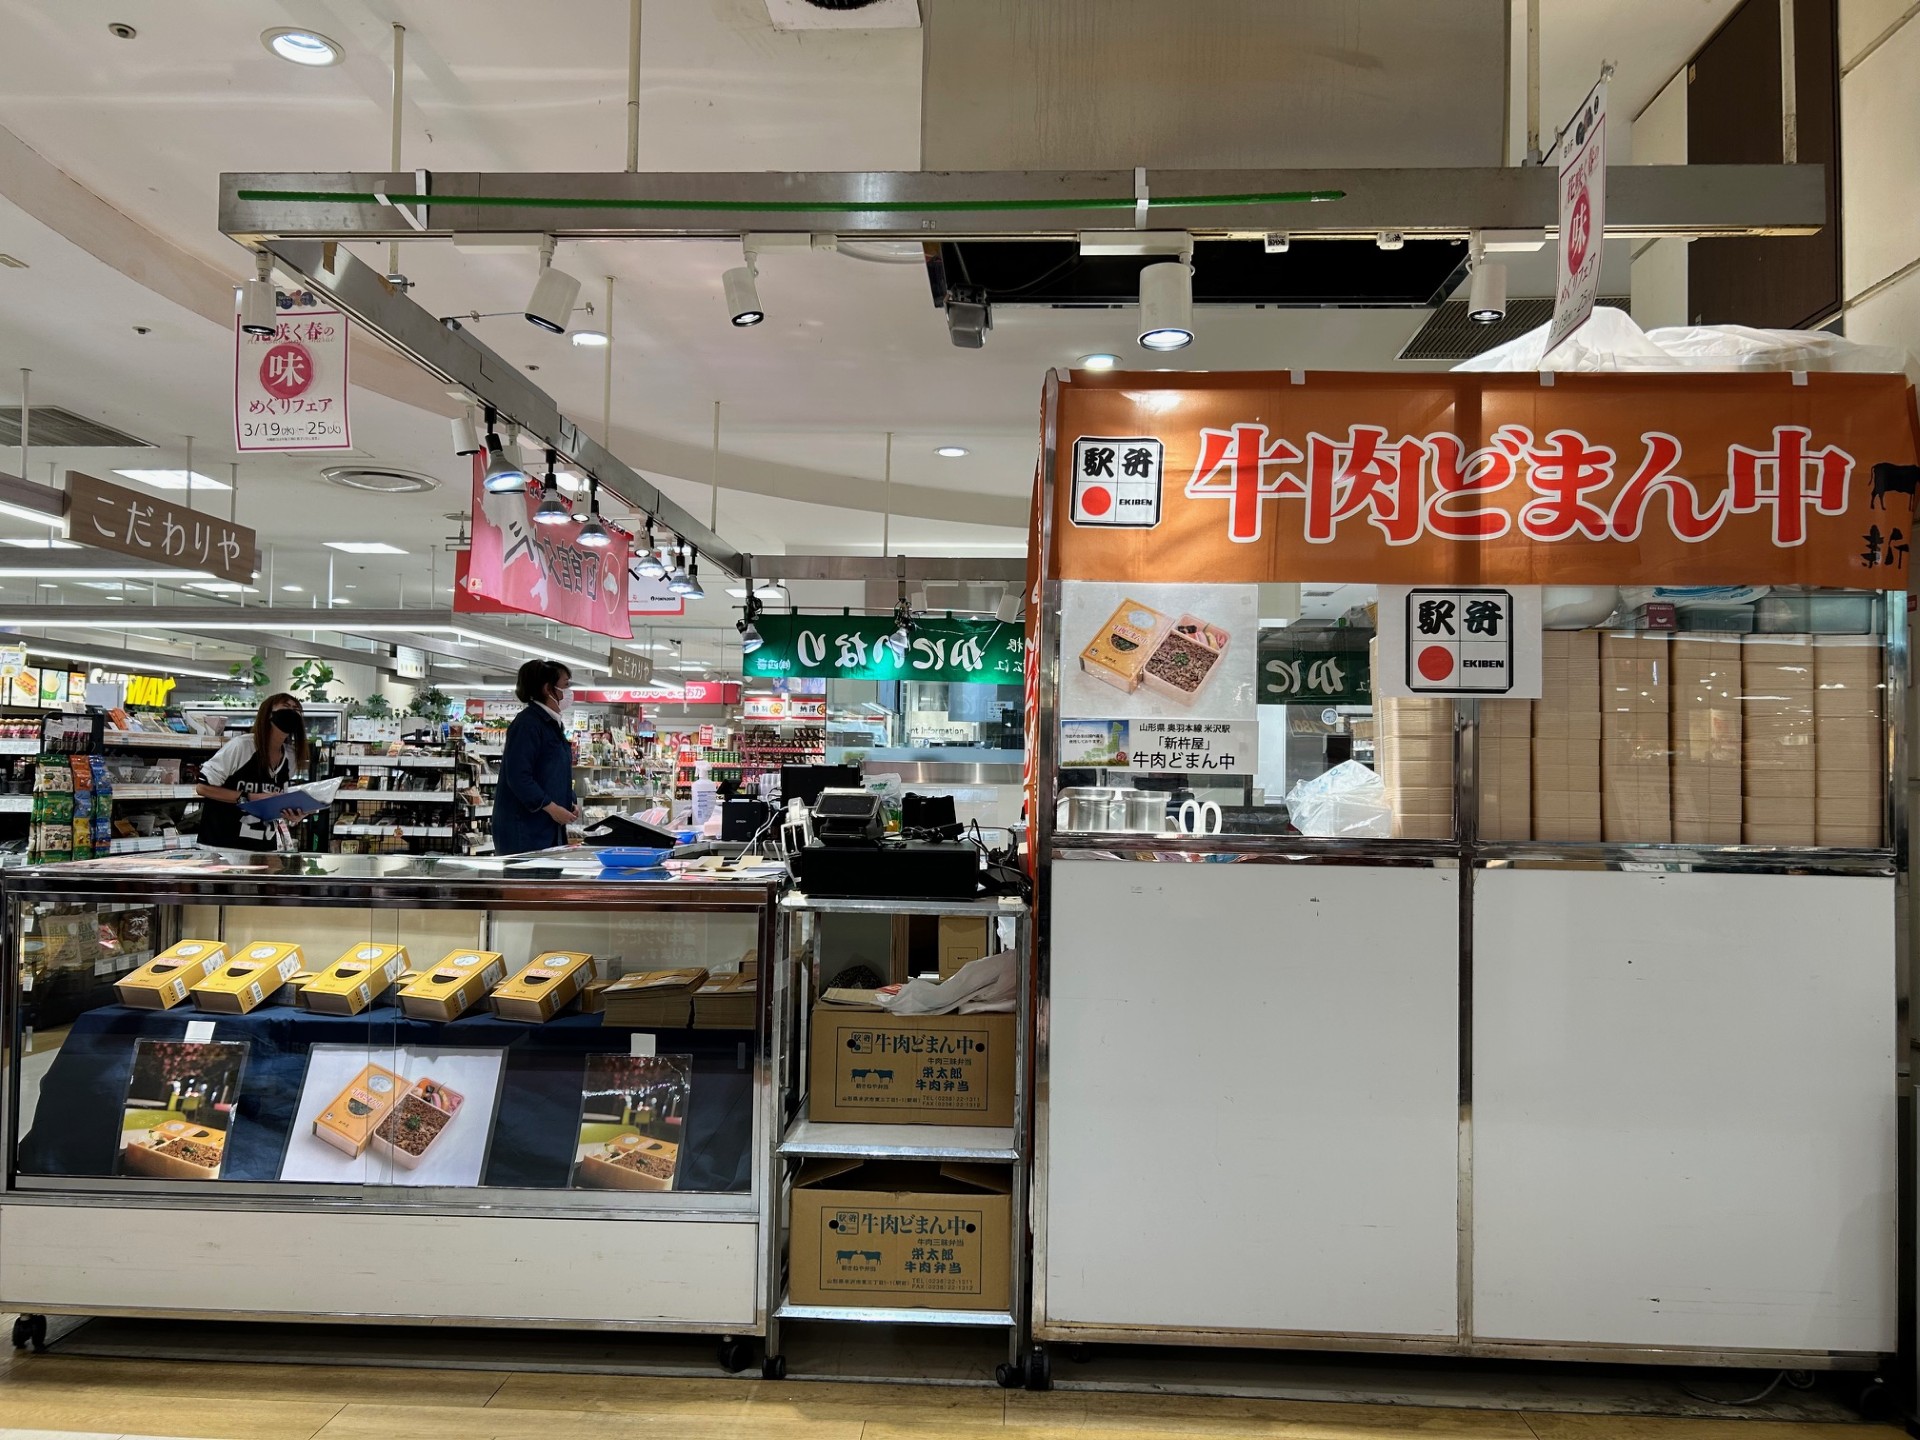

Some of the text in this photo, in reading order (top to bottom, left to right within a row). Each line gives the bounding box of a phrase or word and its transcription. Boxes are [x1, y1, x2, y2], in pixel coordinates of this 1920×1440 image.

[1571, 203, 1588, 260] 味
[269, 352, 305, 387] 味
[249, 397, 333, 415] めぐりフェア
[1082, 446, 1154, 479] 駅弁
[1185, 423, 1856, 547] 牛肉どまん中
[1118, 497, 1154, 507] EKIBEN
[92, 496, 241, 571] こだわりや
[1417, 599, 1504, 637] 駅弁
[616, 656, 650, 680] こだわりや
[1463, 659, 1505, 668] EKIBEN
[1139, 723, 1231, 734] 山形県 奥羽本線 米沢駅
[1158, 736, 1212, 750] 「新杵屋」
[1132, 752, 1235, 770] 牛肉どまん中
[875, 1033, 974, 1055] 牛肉どまん中
[922, 1066, 963, 1080] 栄太郎
[915, 1079, 970, 1092] 牛肉弁当
[861, 1213, 967, 1236] 牛肉どまん中
[911, 1247, 955, 1261] 栄太郎
[904, 1261, 962, 1274] 牛肉弁当
